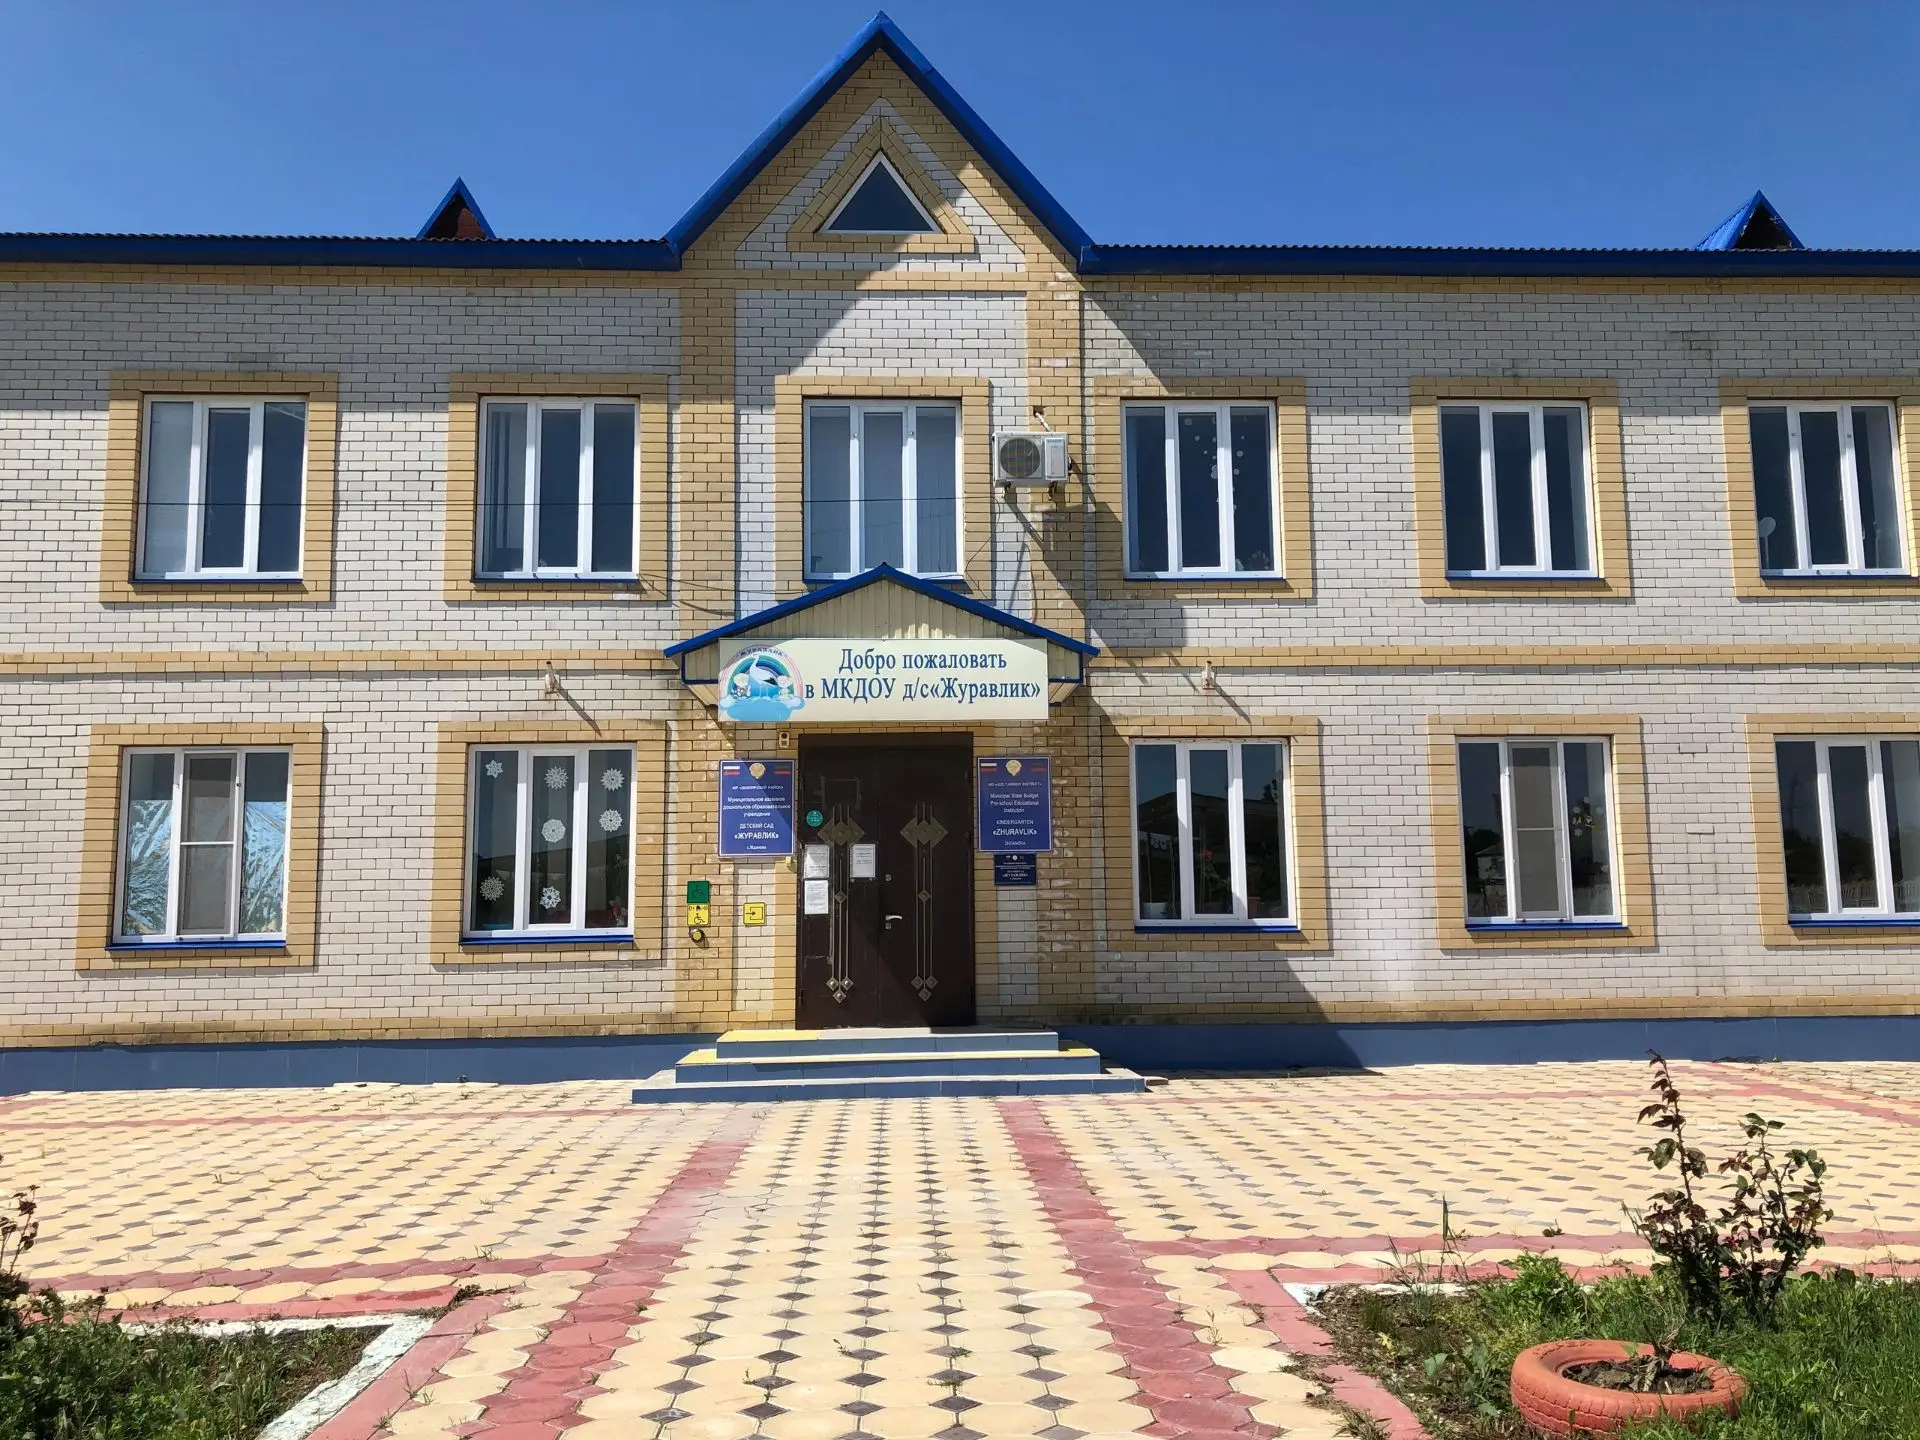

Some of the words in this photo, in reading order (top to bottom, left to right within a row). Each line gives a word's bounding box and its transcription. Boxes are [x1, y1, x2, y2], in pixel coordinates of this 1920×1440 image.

[838, 648, 896, 675] Добро
[902, 653, 1007, 669] пожаловать
[805, 684, 815, 699] в
[820, 677, 897, 704] МКДОУ
[734, 831, 779, 840] «ЖУРАВЛИК»
[992, 828, 1038, 836] «ZHURAVLIK»
